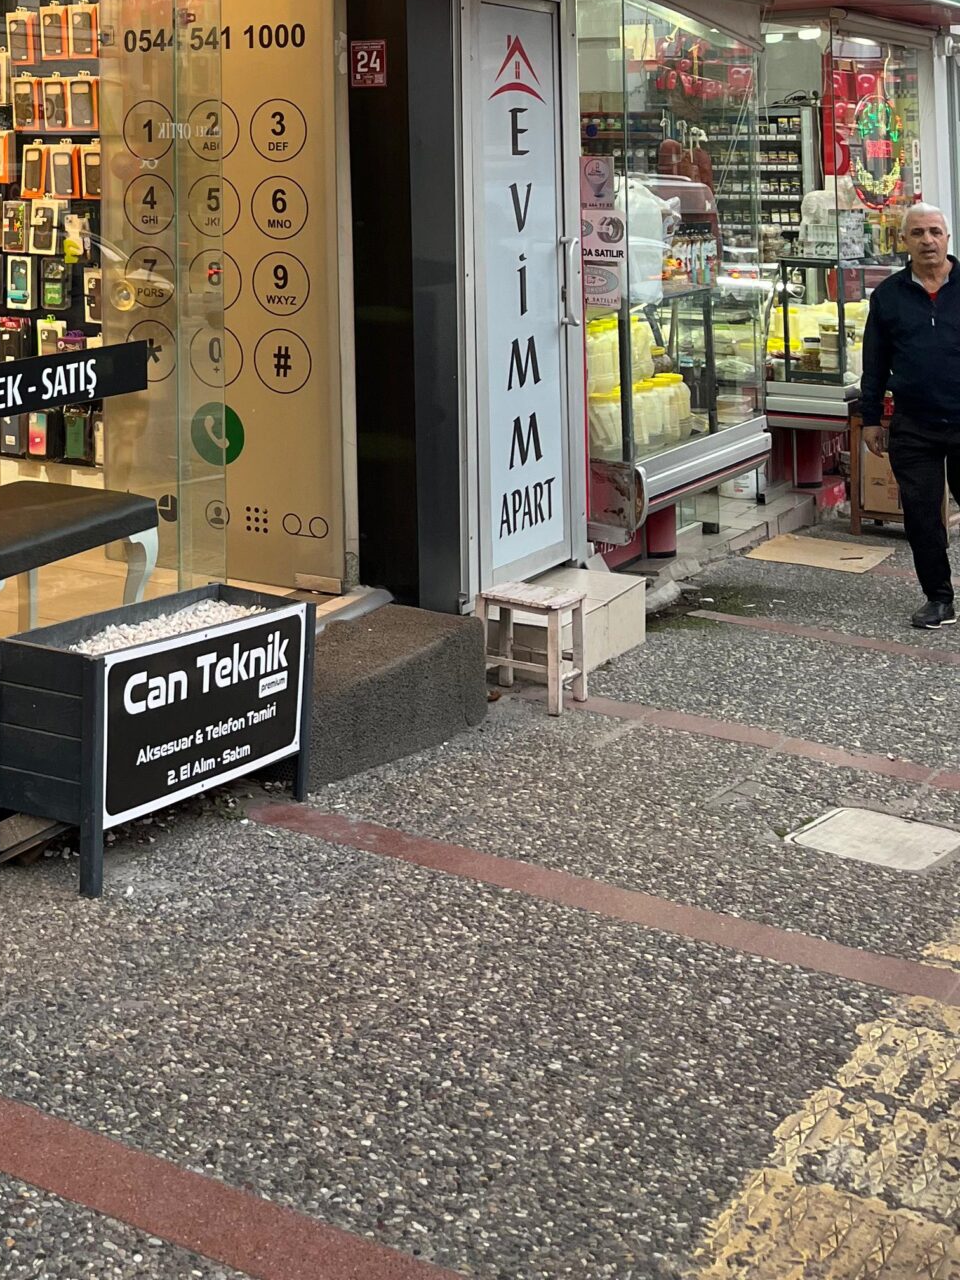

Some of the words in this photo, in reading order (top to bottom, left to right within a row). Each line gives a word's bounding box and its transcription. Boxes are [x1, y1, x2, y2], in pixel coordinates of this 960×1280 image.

[190, 26, 231, 51] 541
[243, 23, 306, 49] 1000
[356, 50, 381, 73] 24
[142, 119, 153, 143] 1
[205, 111, 220, 136] 2
[270, 111, 286, 137] 3
[268, 141, 289, 151] DEF
[142, 186, 157, 210] 4
[206, 187, 220, 212] 5
[271, 188, 288, 214] 6
[141, 215, 159, 225] GHI
[267, 219, 292, 229] MNO
[594, 248, 624, 259] SATILIR
[272, 264, 289, 290] 9
[137, 288, 164, 298] PQRS
[266, 294, 297, 306] WXYZ
[41, 358, 98, 399] SATIŞ
[499, 477, 556, 539] APART
[123, 669, 188, 715] Can
[196, 630, 290, 694] Teknik
[260, 676, 287, 694] premium
[136, 733, 194, 766] Aksesuar
[195, 729, 204, 745] &
[205, 717, 246, 741] Telefon
[246, 702, 277, 727] Tamiri
[167, 769, 179, 786] 2.
[180, 762, 191, 782] El
[192, 756, 216, 778] Alım
[222, 743, 251, 765] Satım
